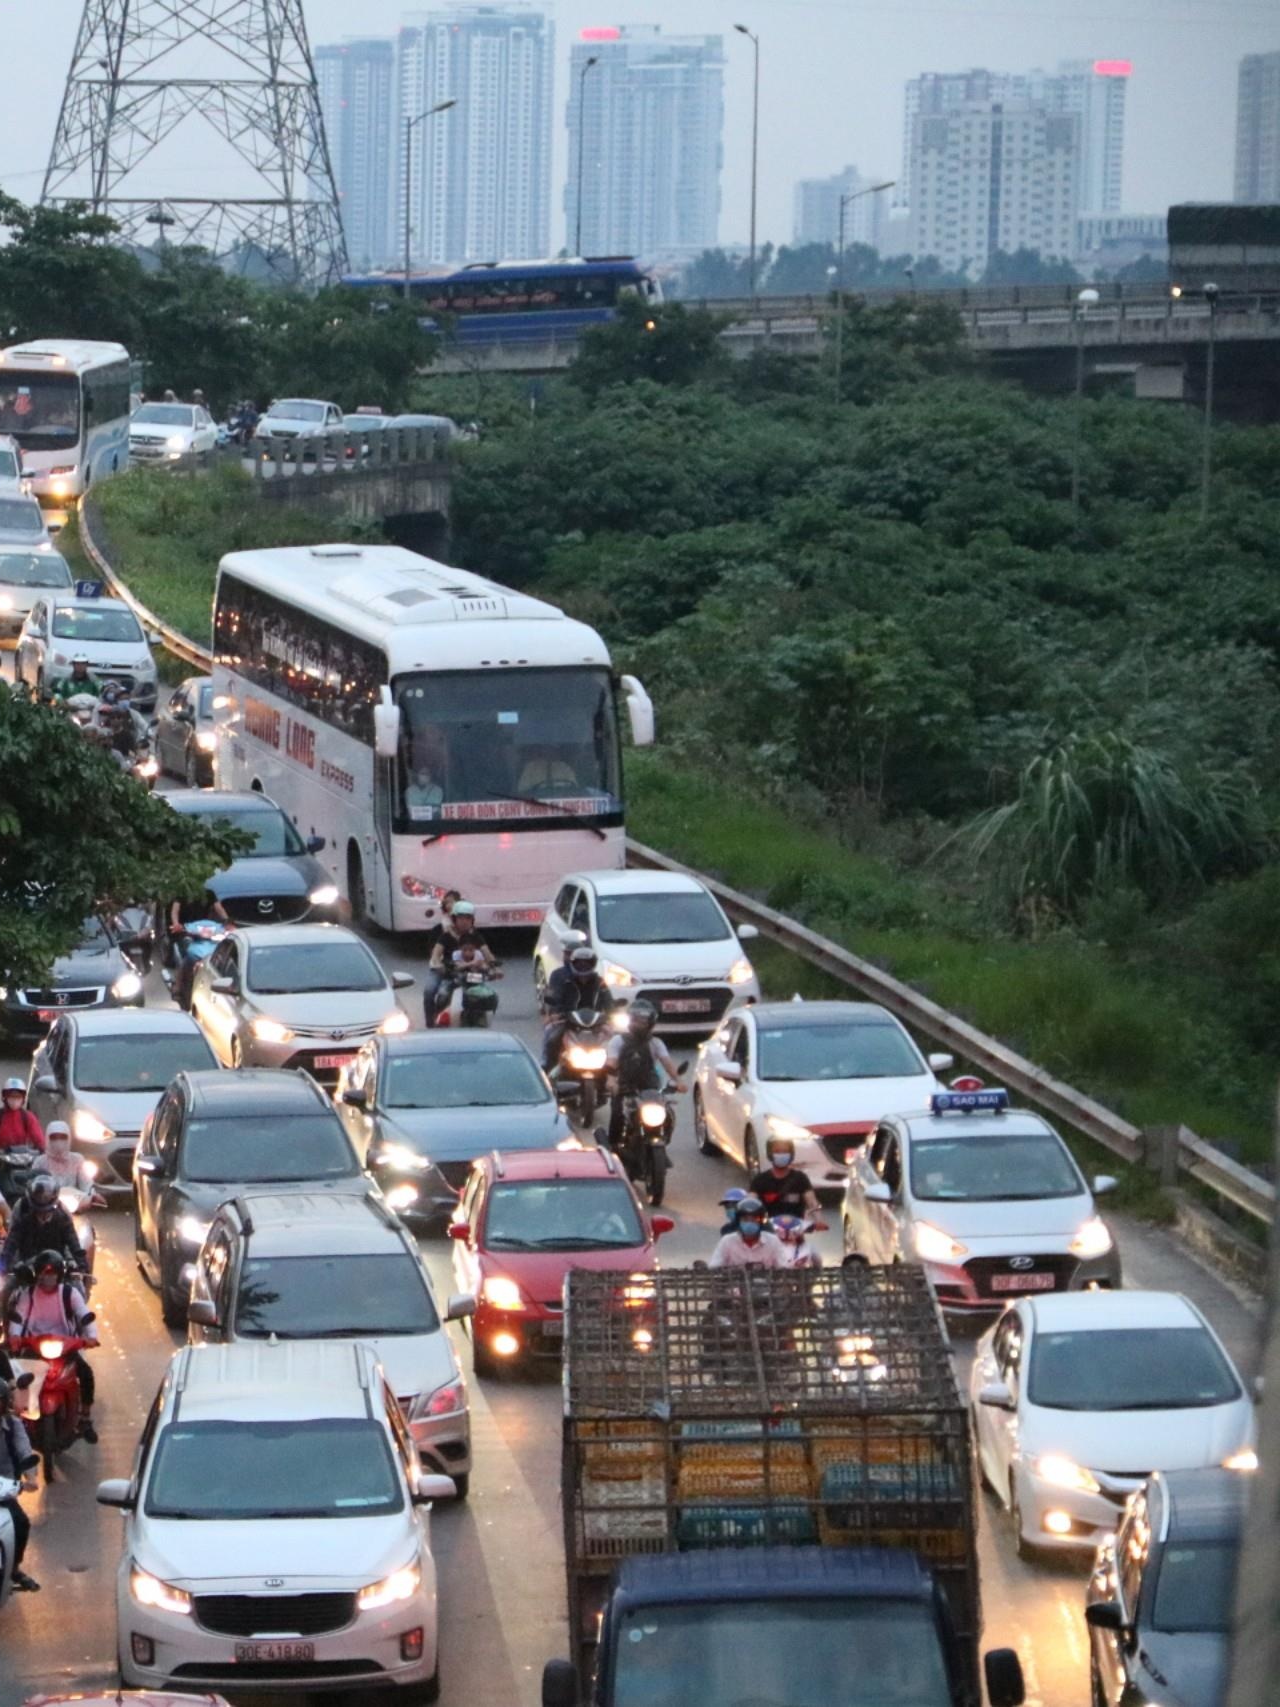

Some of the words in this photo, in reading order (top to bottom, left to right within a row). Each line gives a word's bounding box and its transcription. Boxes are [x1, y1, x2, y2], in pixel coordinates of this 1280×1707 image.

[287, 717, 316, 771] LONG
[321, 760, 354, 793] EXPRESS
[952, 1096, 975, 1106] SAO
[978, 1095, 999, 1105] MAI
